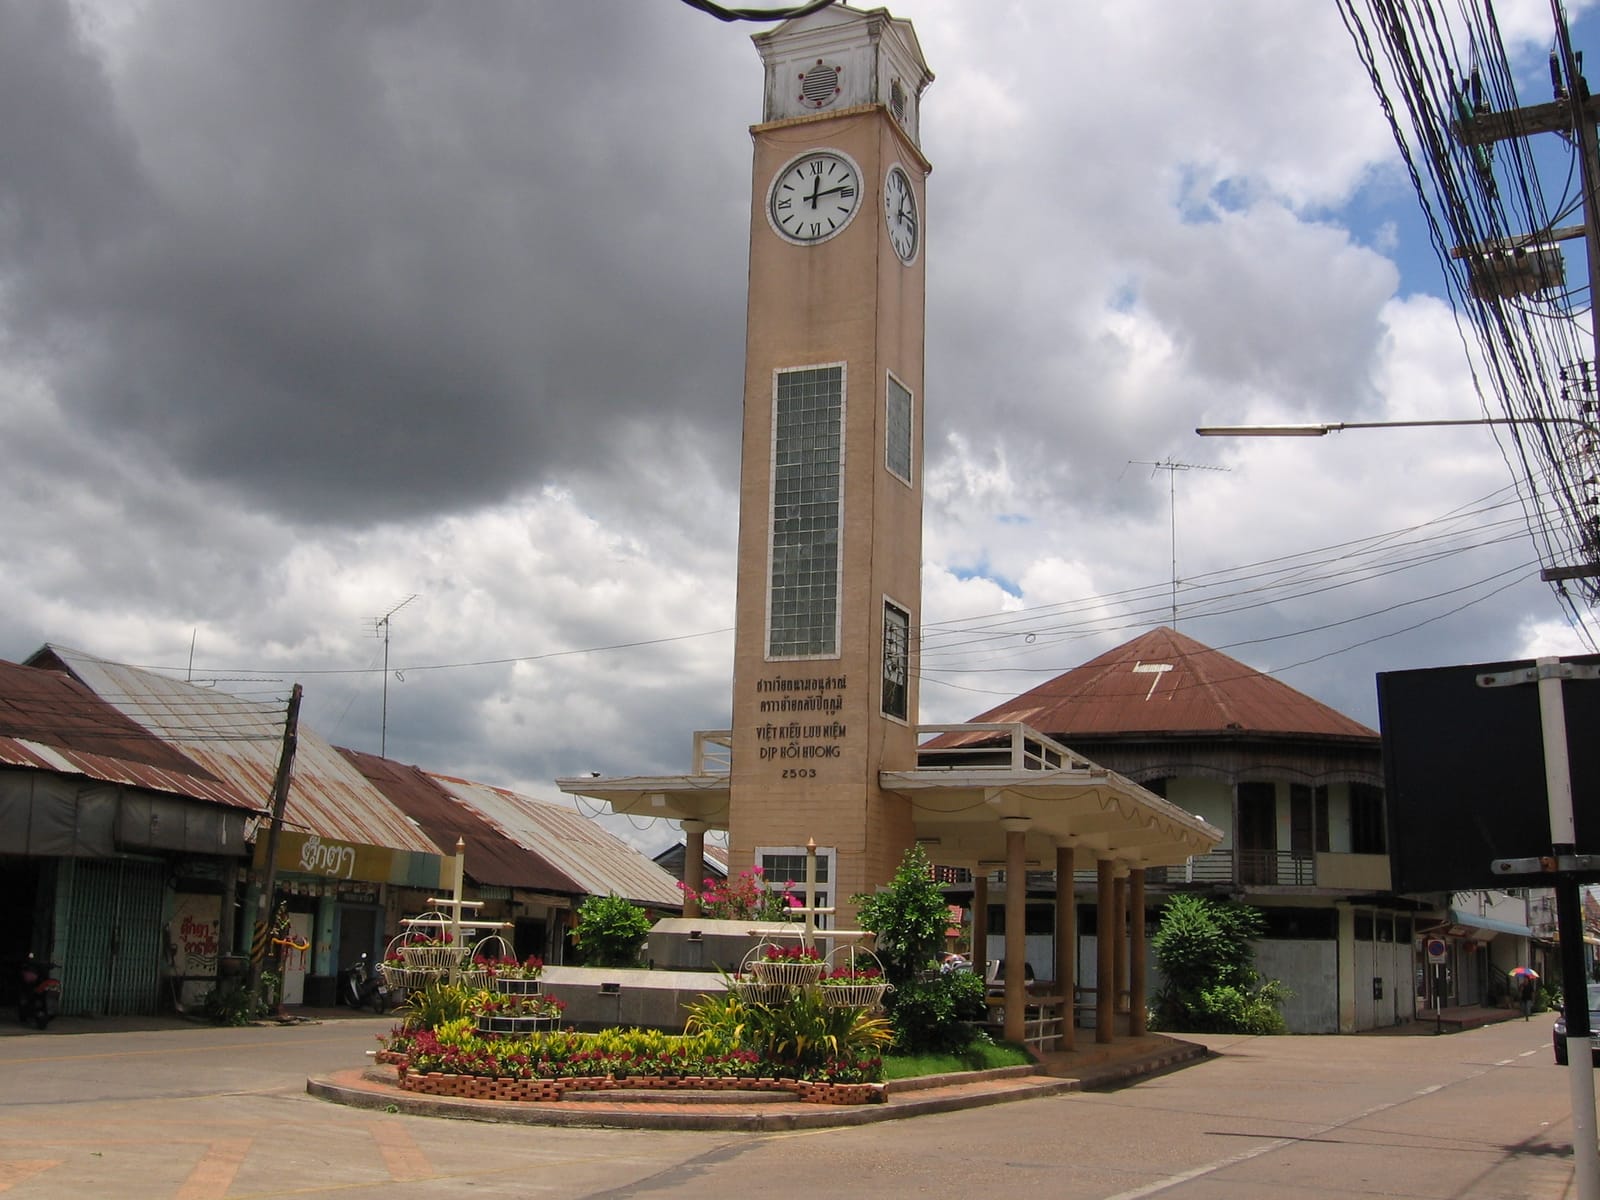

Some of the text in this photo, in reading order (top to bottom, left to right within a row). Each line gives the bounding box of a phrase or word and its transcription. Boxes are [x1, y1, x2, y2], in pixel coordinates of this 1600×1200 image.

[782, 768, 817, 779] 2503
[299, 835, 356, 879] ตุ๊กตา
